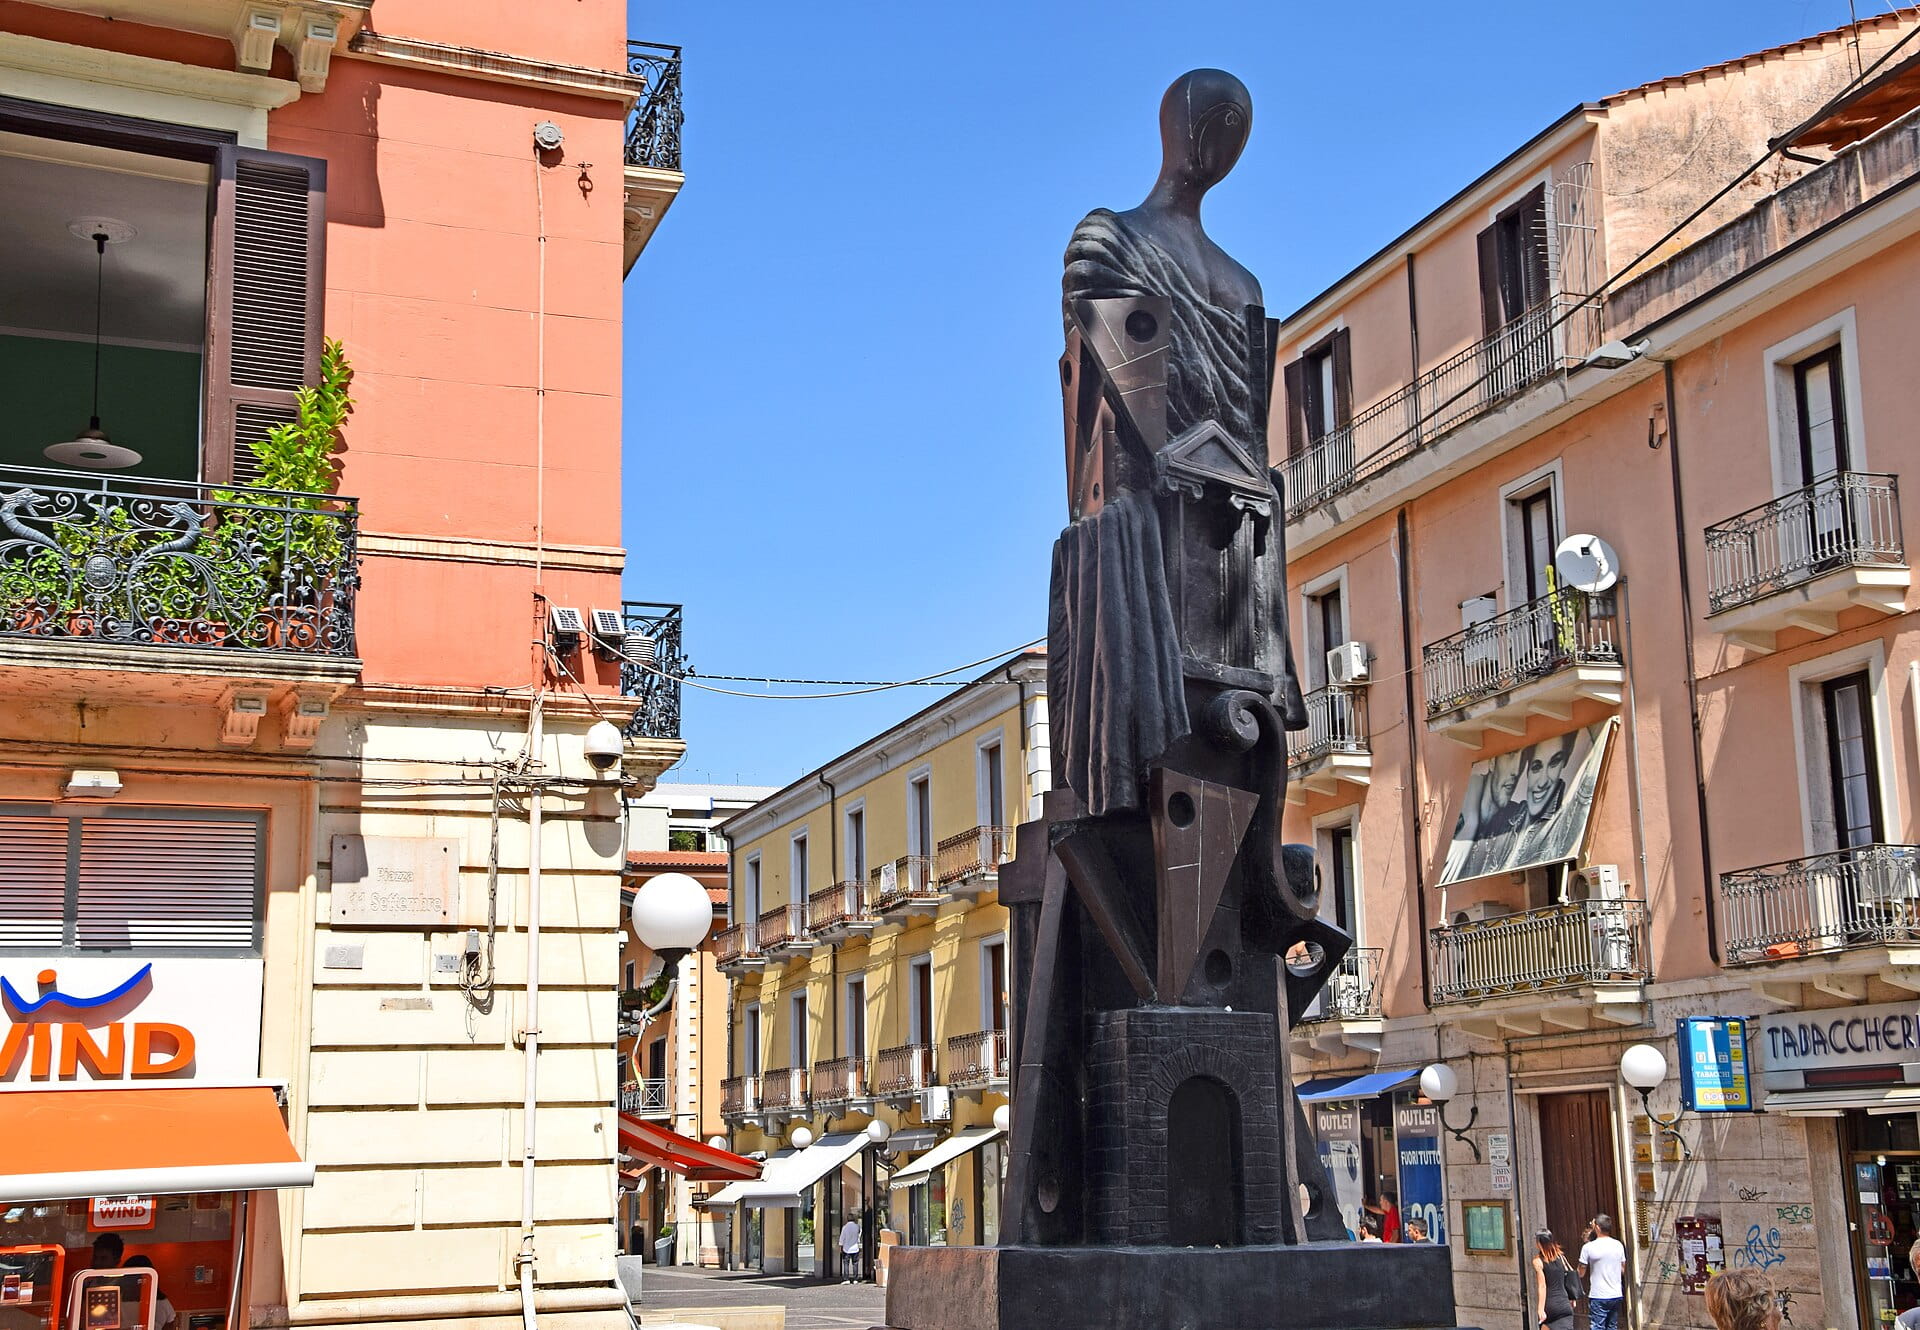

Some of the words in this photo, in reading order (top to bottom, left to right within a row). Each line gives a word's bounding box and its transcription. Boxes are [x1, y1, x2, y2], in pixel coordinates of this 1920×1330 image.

[377, 867, 414, 882] Piazza
[370, 891, 442, 912] Settembre
[0, 1022, 196, 1081] IND
[1320, 1113, 1353, 1130] OUTLET
[1400, 1108, 1436, 1126] OUTLET
[100, 1205, 146, 1219] WIND
